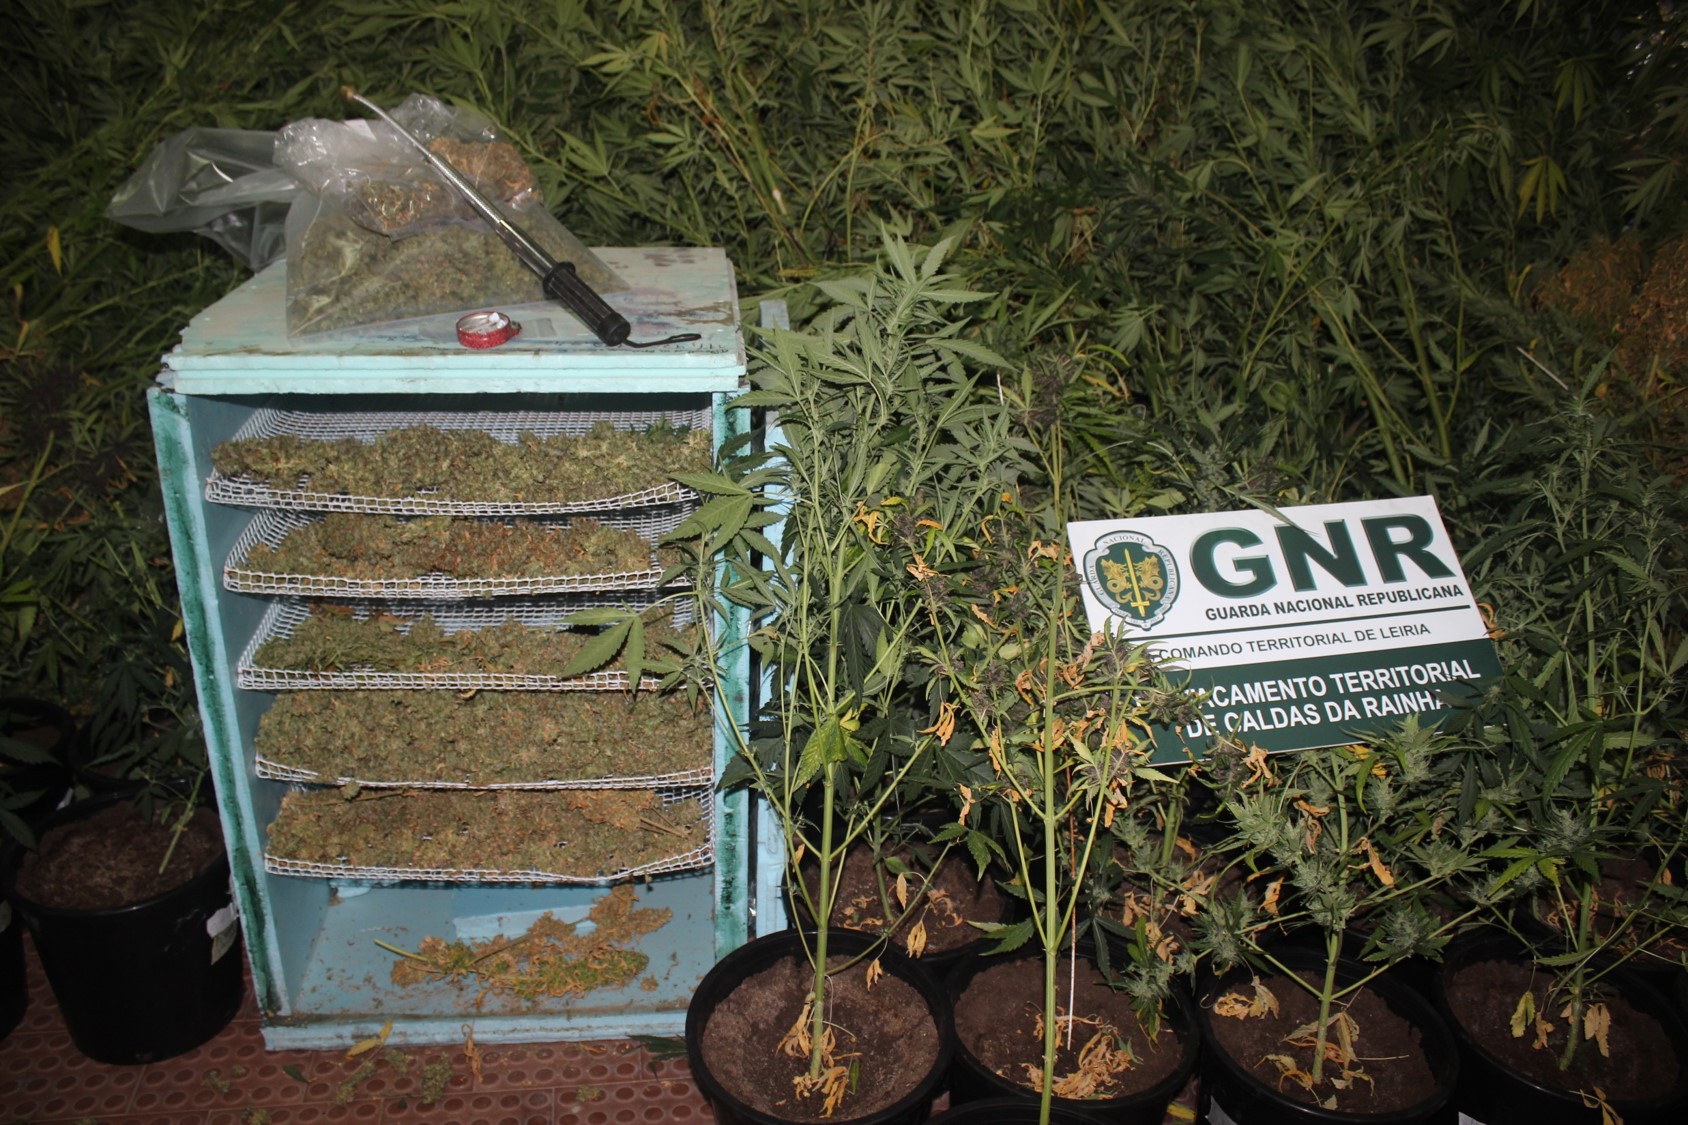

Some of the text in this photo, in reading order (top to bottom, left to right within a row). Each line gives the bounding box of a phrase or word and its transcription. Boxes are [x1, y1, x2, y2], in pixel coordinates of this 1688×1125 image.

[1103, 534, 1146, 545] NACIONAL
[1189, 513, 1457, 599] GNR
[1205, 584, 1464, 621] GUARDA NACIONAL REPUBLICANA
[1159, 623, 1431, 661] COMANDO TERRITORIAL DE LEIRIA
[1329, 659, 1481, 694] TERRITORIAL
[1186, 714, 1219, 738] DE
[1223, 703, 1321, 733] CALDAS
[1324, 699, 1361, 723] DA
